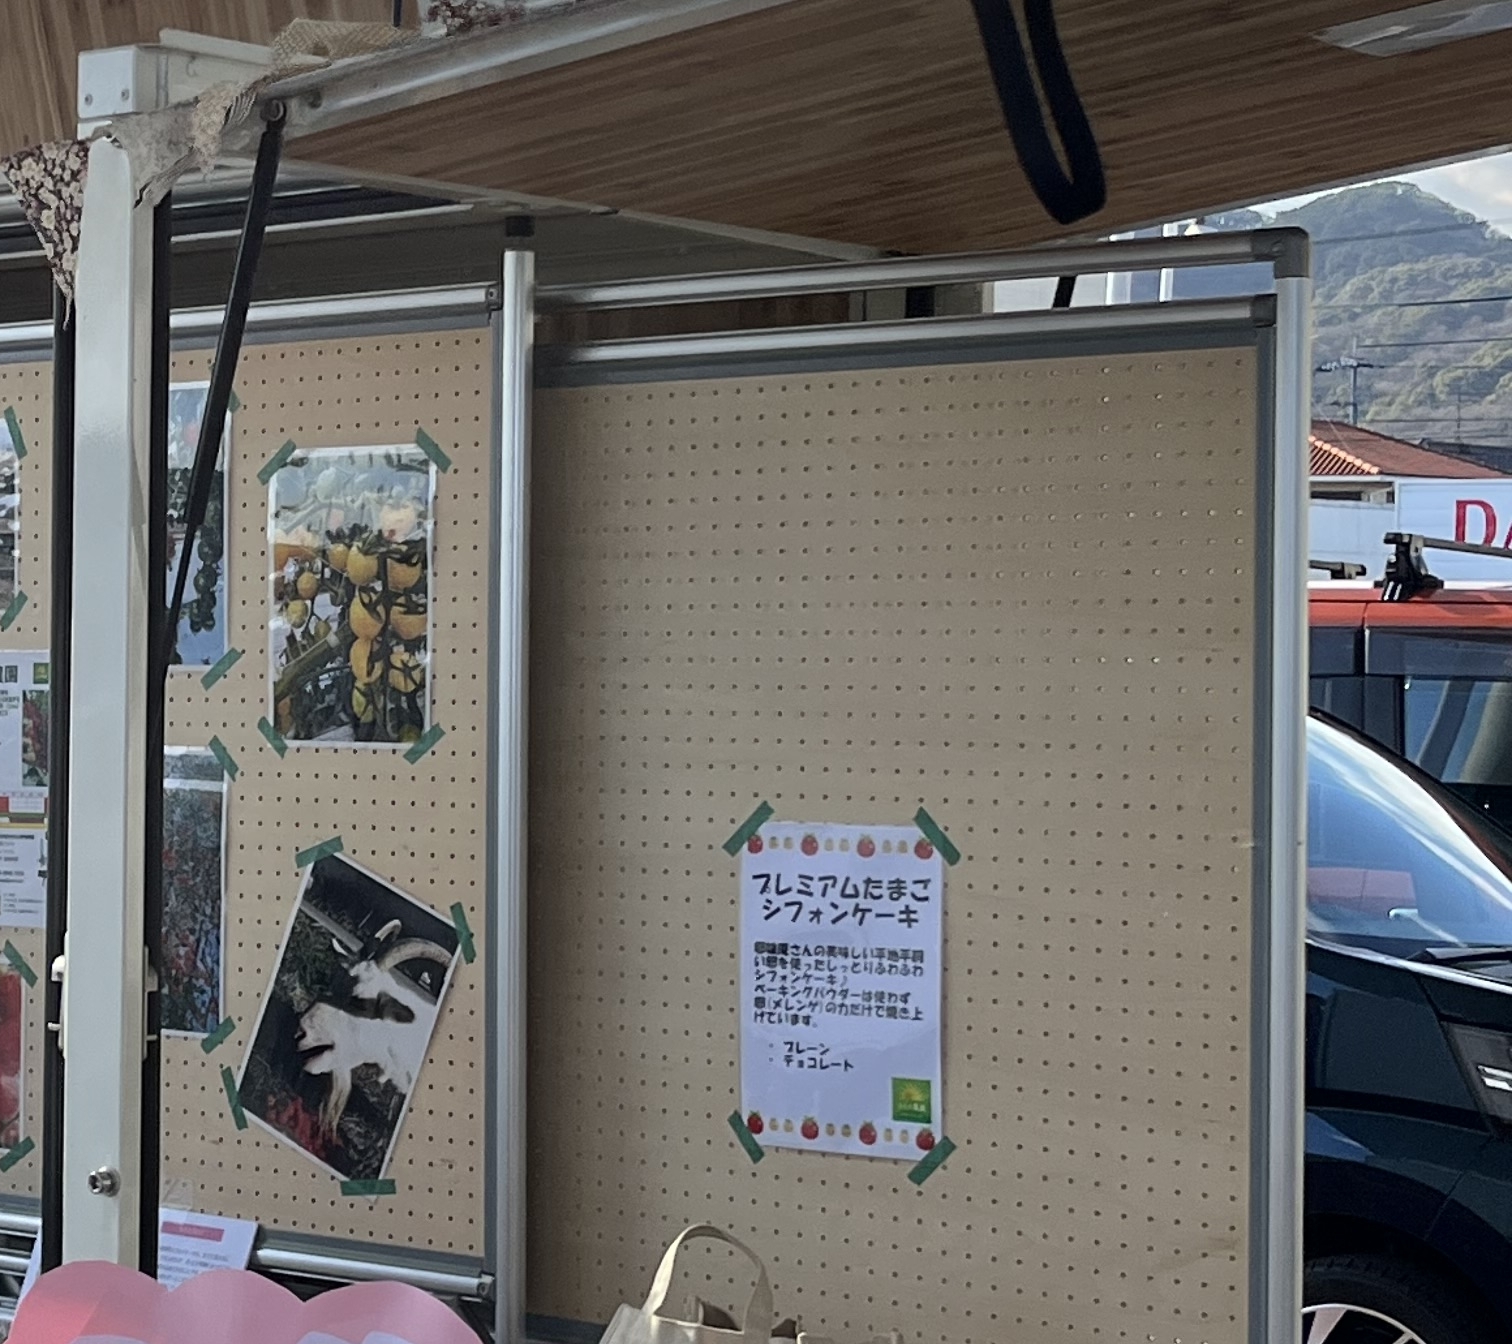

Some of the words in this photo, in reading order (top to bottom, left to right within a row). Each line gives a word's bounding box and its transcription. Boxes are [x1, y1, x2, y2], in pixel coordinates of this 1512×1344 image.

[752, 872, 931, 902] プレミアムたまご
[762, 898, 919, 929] シフォンケーキ
